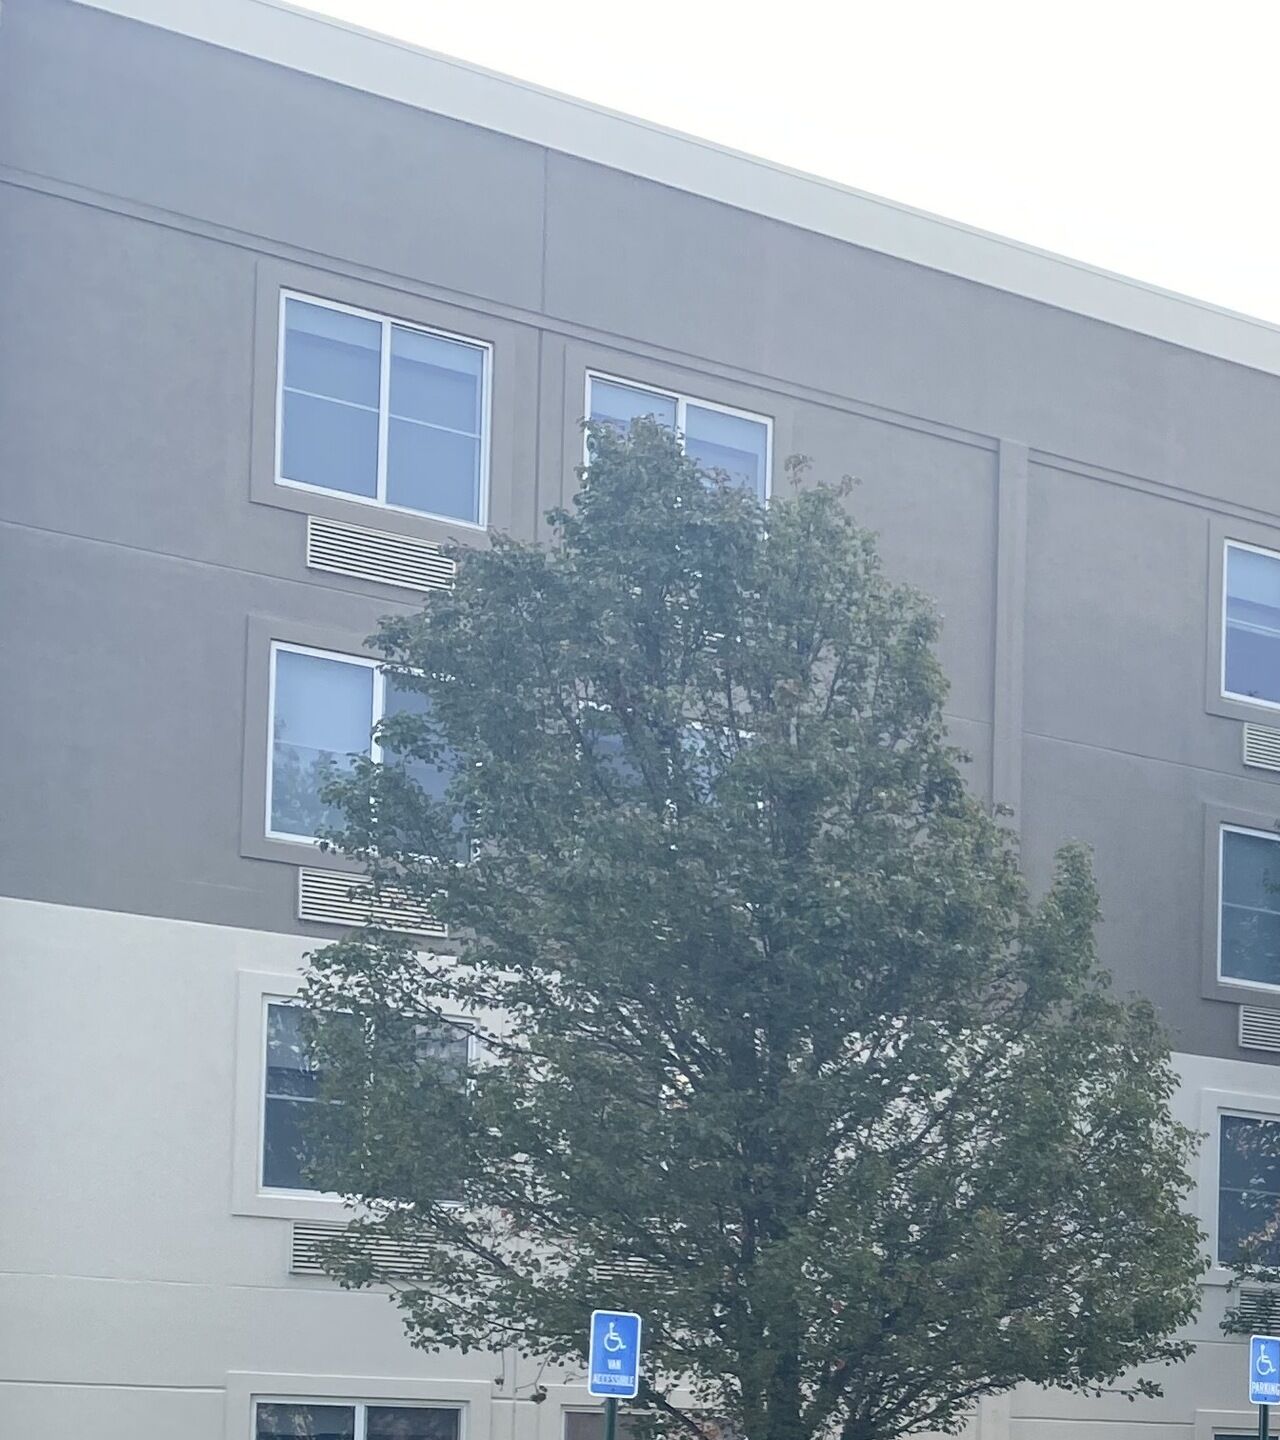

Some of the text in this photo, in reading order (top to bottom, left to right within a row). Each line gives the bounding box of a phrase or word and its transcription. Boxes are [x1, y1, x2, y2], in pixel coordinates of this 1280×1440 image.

[608, 1360, 622, 1370] VAN
[592, 1373, 634, 1387] ACCESSIBLE
[1251, 1381, 1280, 1396] PARKING
